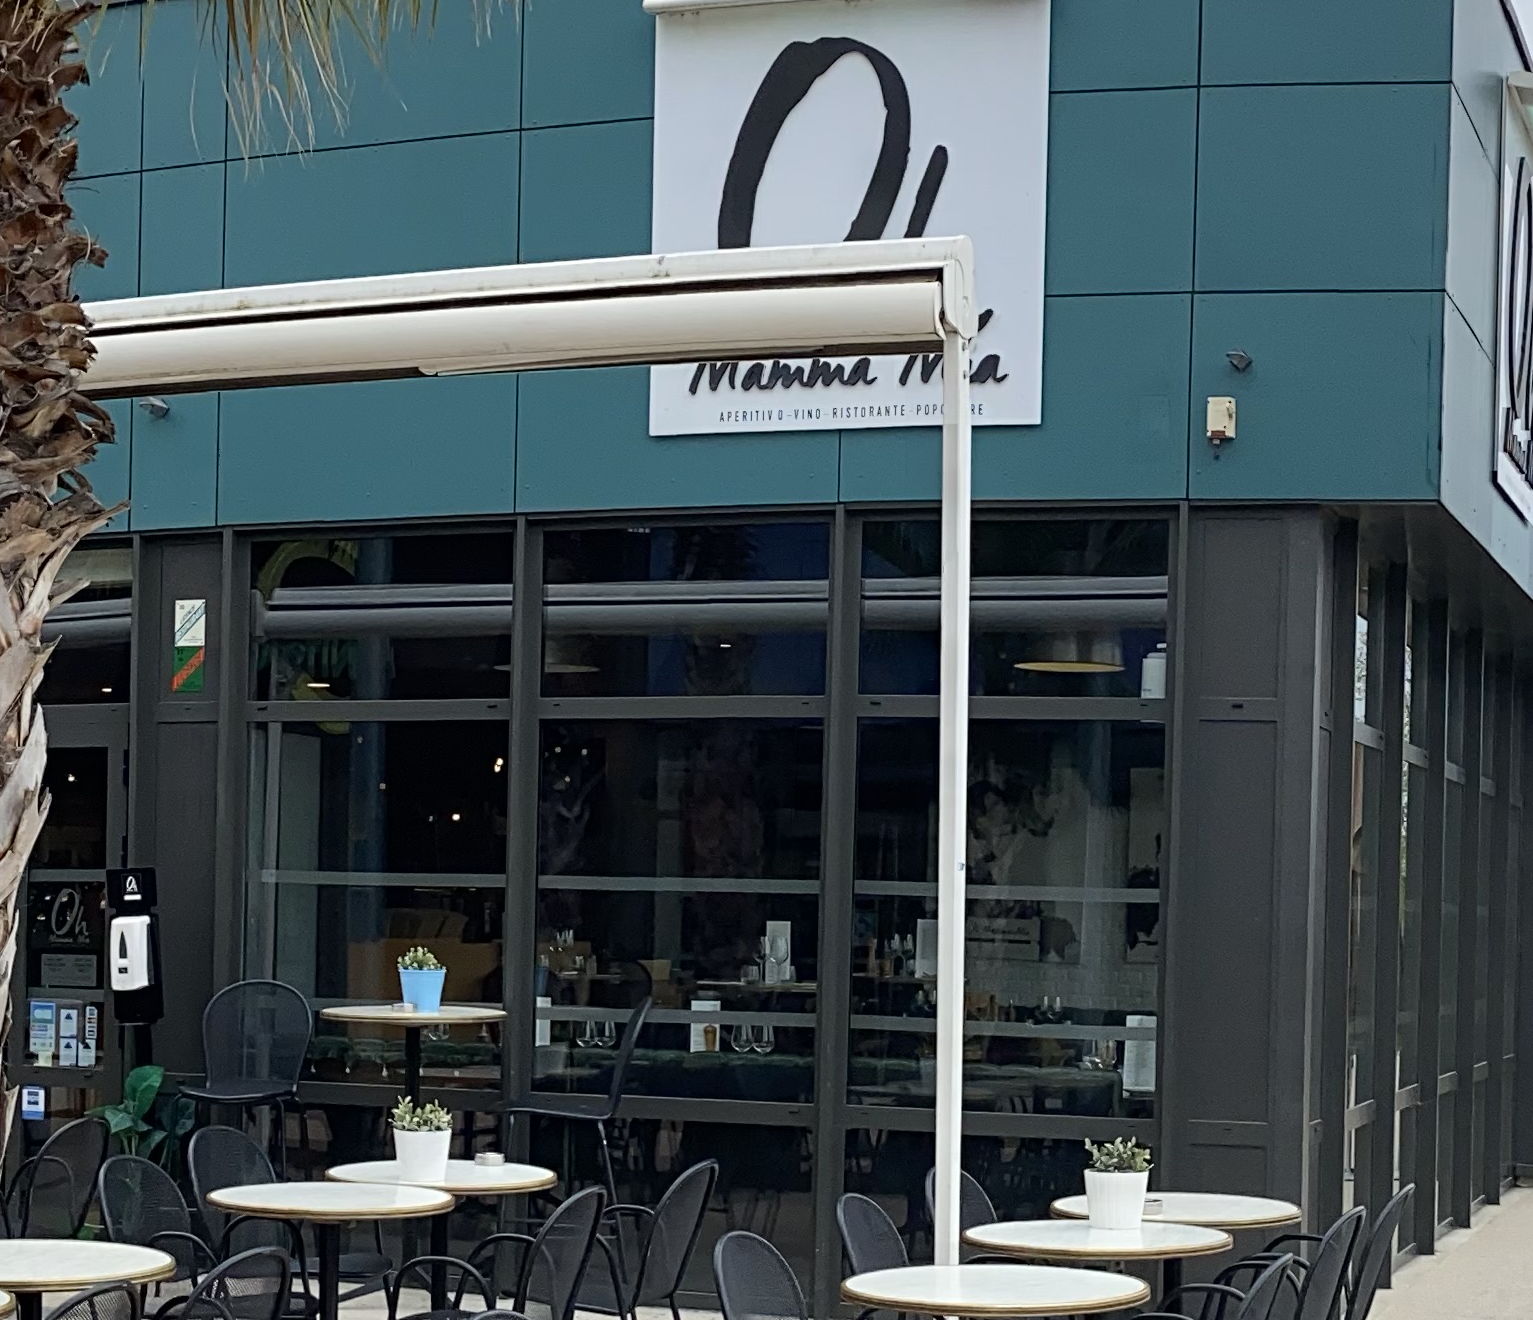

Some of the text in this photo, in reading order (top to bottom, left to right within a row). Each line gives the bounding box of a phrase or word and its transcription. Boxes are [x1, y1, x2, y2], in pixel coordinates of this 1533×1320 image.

[688, 353, 1010, 395] Mamma Ma
[51, 888, 89, 936] Oh
